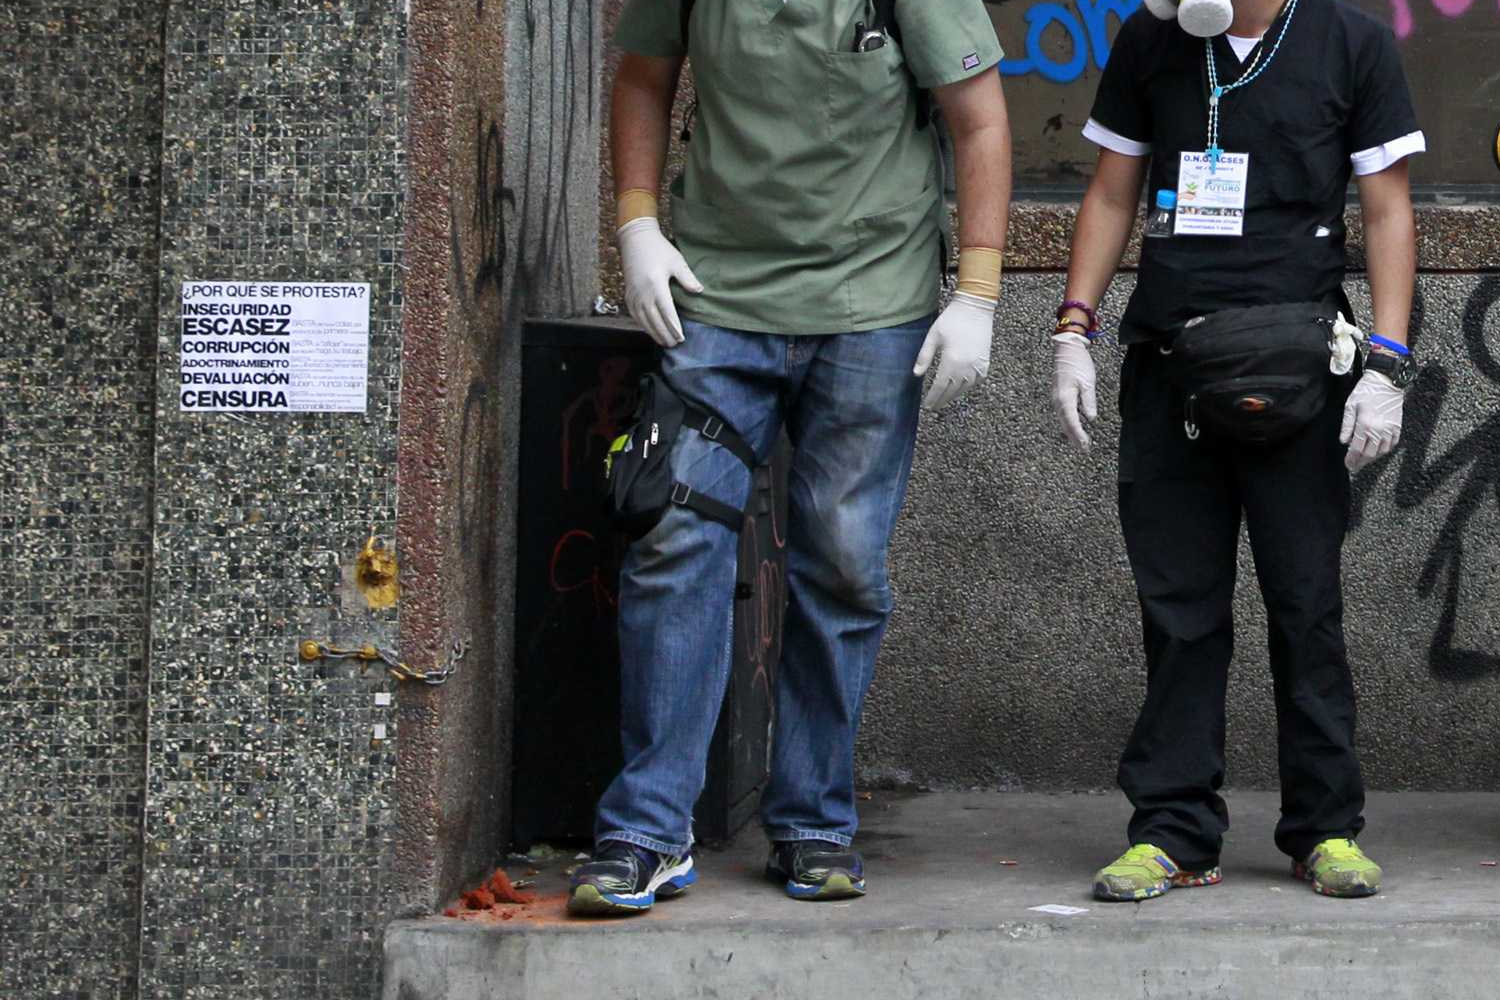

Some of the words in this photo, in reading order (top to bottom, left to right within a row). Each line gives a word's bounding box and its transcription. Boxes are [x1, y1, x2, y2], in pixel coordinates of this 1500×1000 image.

[183, 284, 222, 299] ¿POR
[226, 282, 257, 298] QUÉ
[260, 285, 279, 298] SE
[282, 286, 366, 299] PROTESTA?
[182, 303, 292, 316] INSEGURIDAD
[182, 318, 290, 336] ESCASEZ
[182, 338, 290, 354] CORRUPCIÓN
[182, 359, 290, 368] ADOCTRINAMIENTO
[181, 369, 290, 385] DEVALUACIÓN
[181, 390, 288, 408] CENSURA
